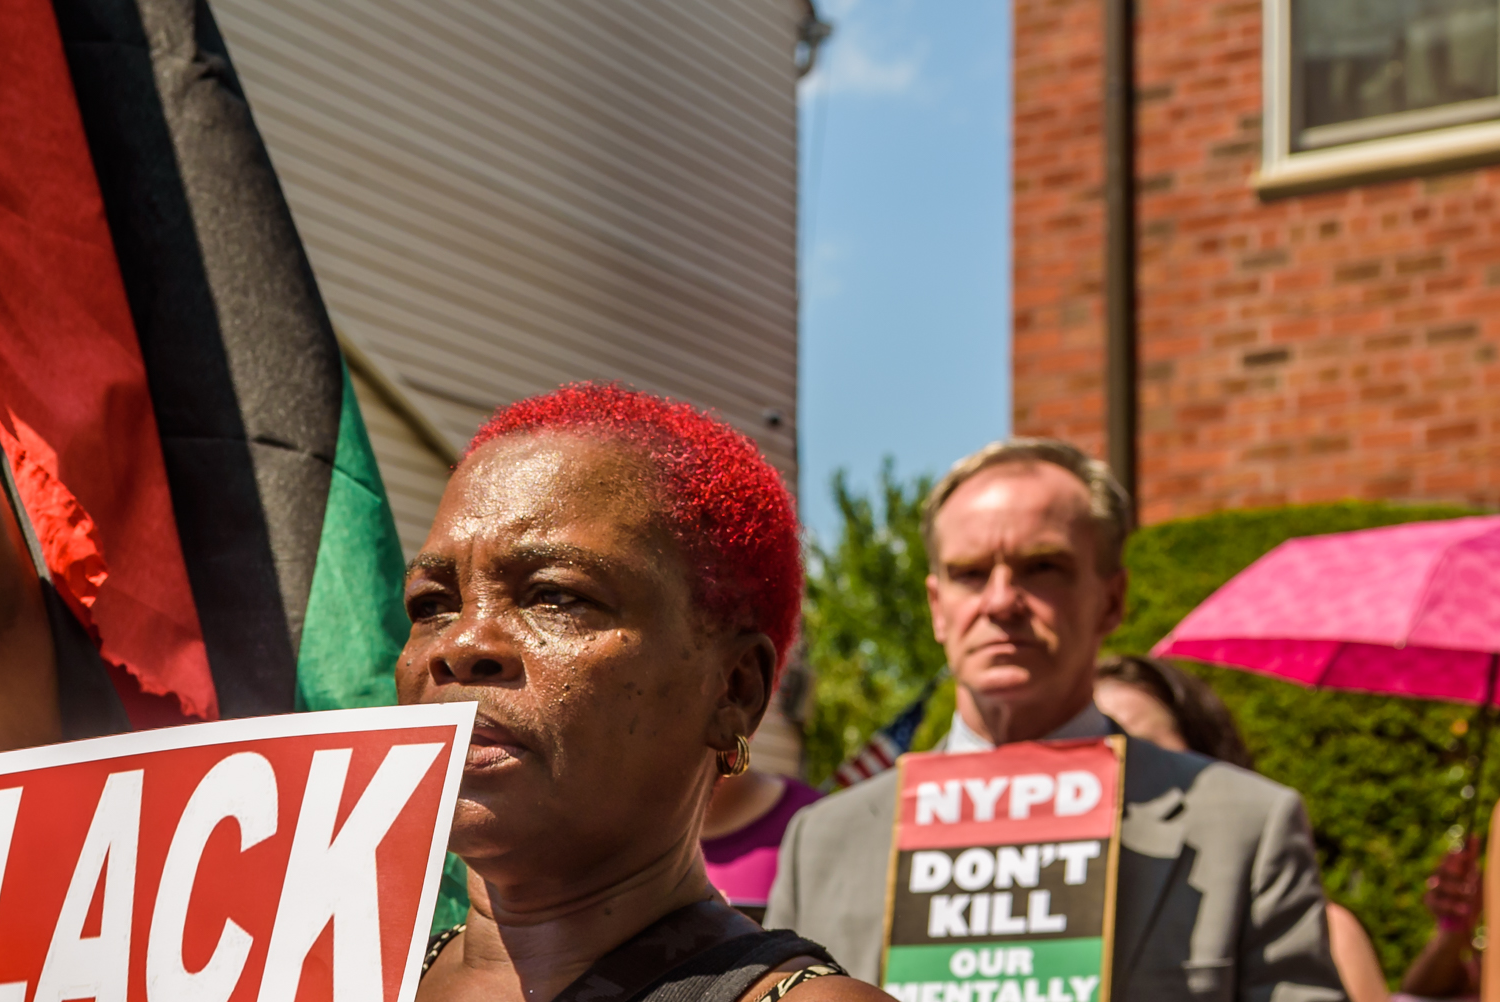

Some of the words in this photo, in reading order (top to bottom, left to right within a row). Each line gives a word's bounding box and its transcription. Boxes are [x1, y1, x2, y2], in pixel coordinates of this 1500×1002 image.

[915, 769, 1103, 826] NYPD
[908, 840, 1102, 893] DON'T
[927, 889, 1068, 938] KILL
[949, 947, 1035, 978] OUR
